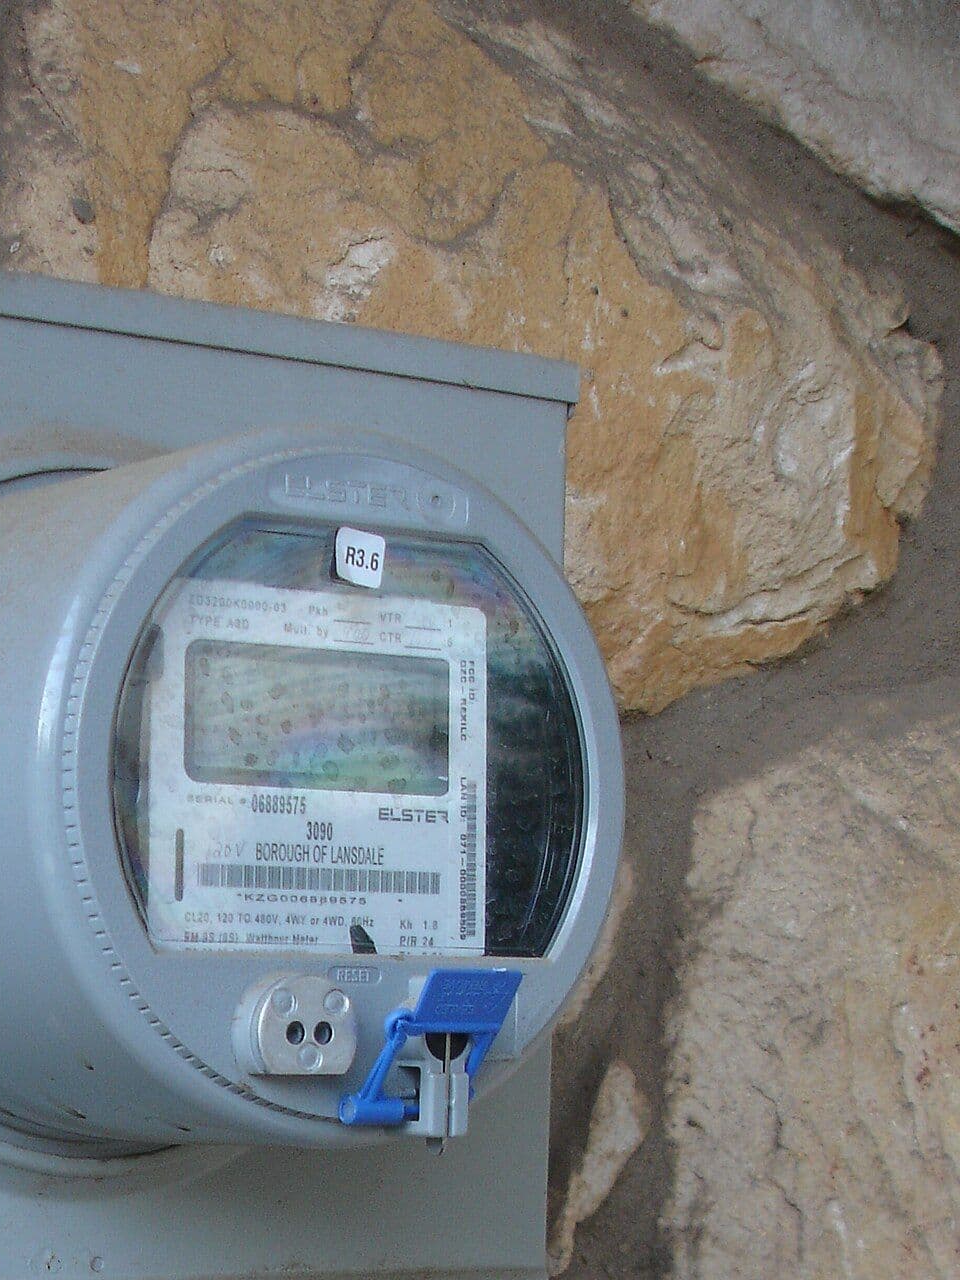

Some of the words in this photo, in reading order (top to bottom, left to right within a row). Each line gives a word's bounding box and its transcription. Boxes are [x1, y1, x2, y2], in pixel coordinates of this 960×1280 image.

[345, 546, 379, 571] R3.6
[380, 611, 402, 624] VTR
[380, 631, 402, 644] CTR
[187, 793, 234, 805] SERIAL
[251, 794, 306, 814] 06889575
[379, 807, 449, 824] ELSTER
[306, 821, 333, 841] 3090
[255, 843, 310, 862] BOROUGH
[313, 845, 327, 863] OF
[331, 846, 384, 866] LANSDALE
[238, 912, 250, 924] TO
[310, 917, 320, 926] or
[399, 919, 413, 930] Kh
[336, 968, 371, 984] RESET
